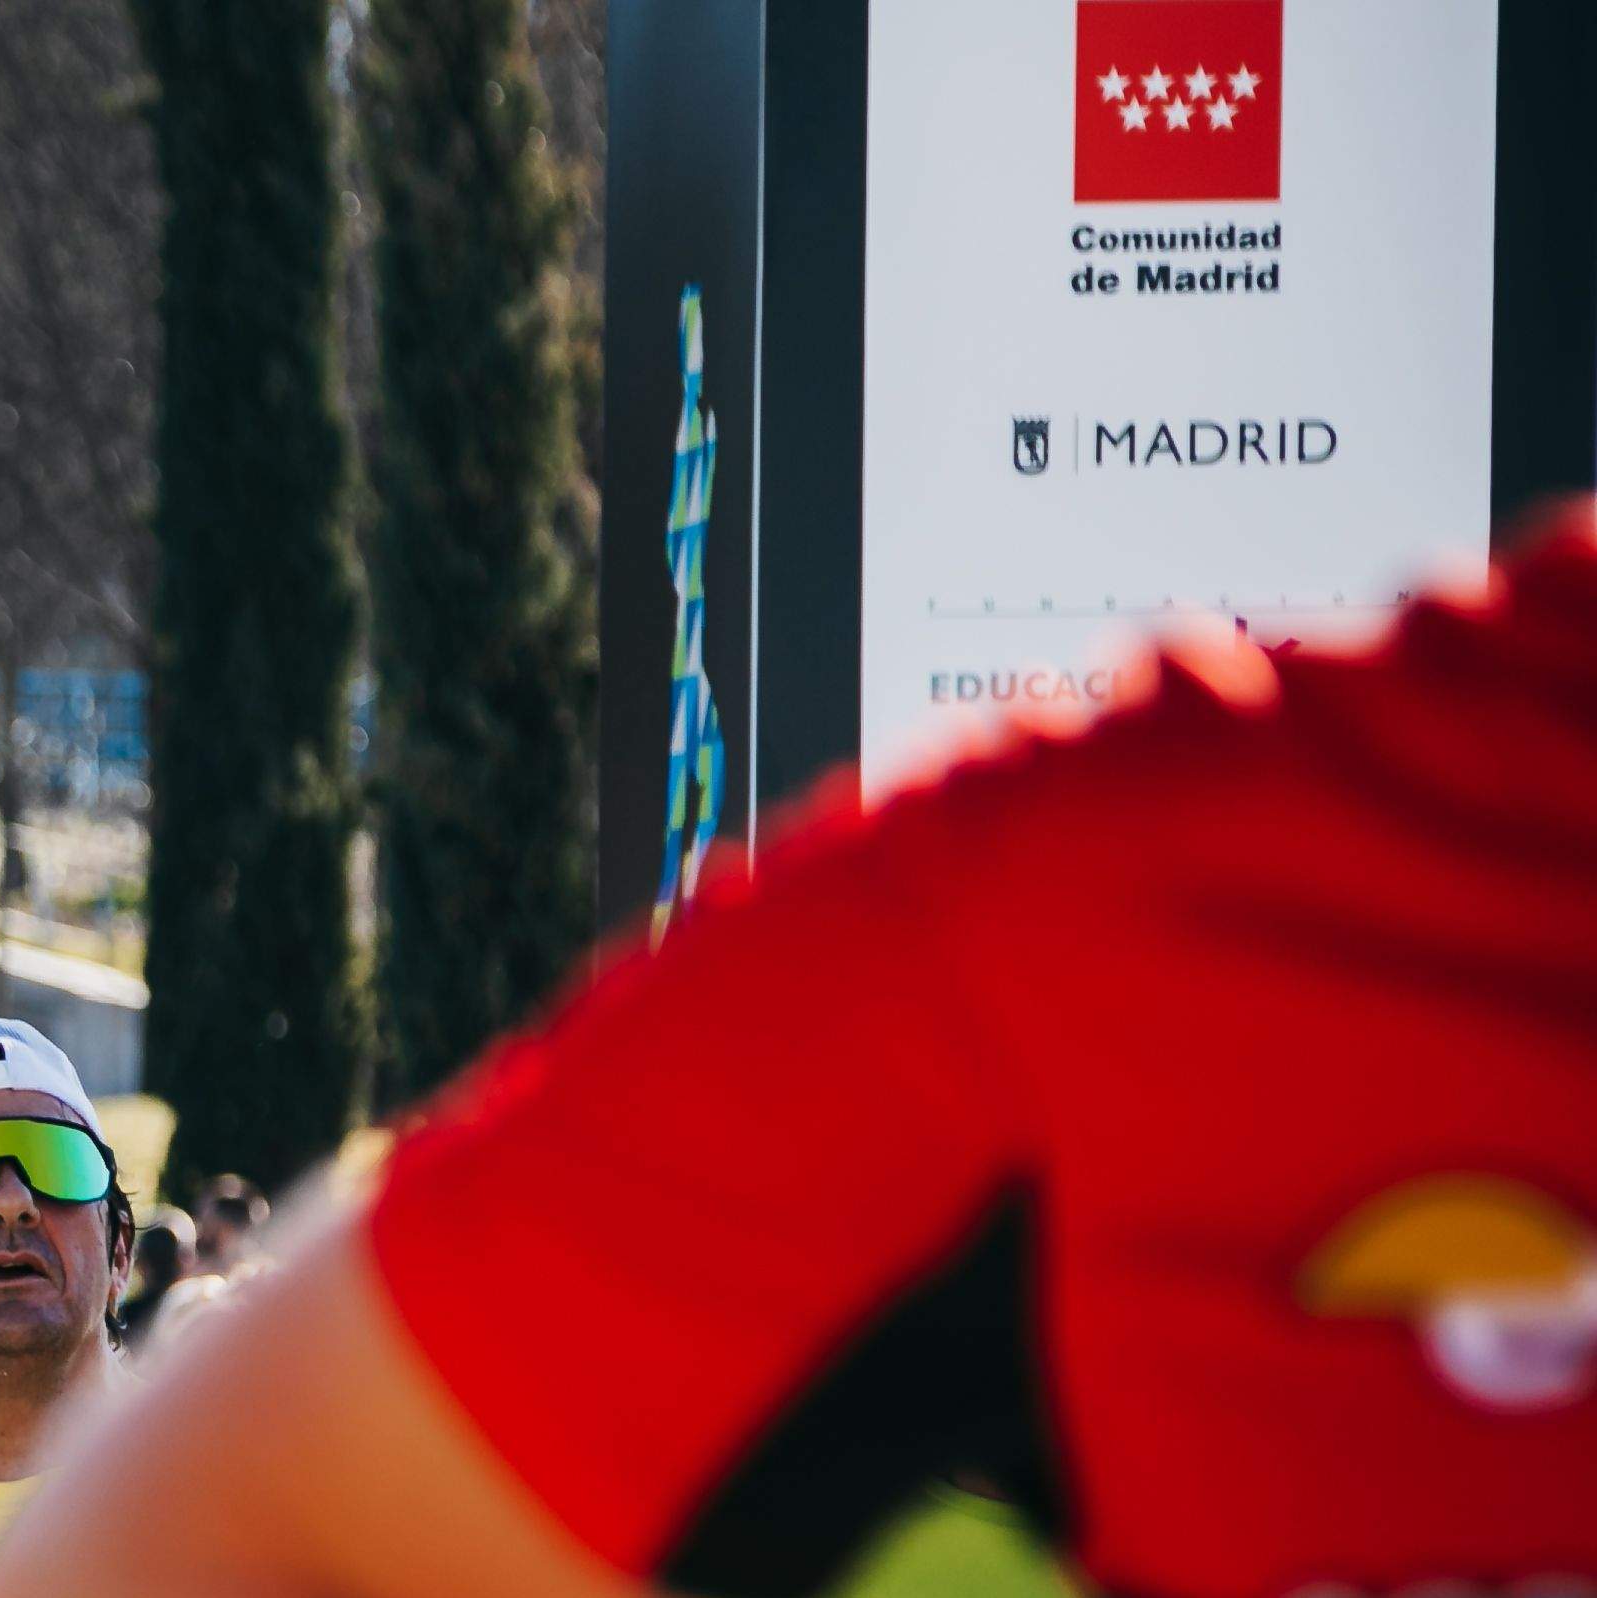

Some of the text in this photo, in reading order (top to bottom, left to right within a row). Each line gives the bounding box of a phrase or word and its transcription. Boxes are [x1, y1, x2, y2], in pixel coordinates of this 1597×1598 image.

[1071, 222, 1282, 253] Comunidad
[1071, 263, 1281, 294] de Madrid
[1094, 418, 1338, 465] MADRID
